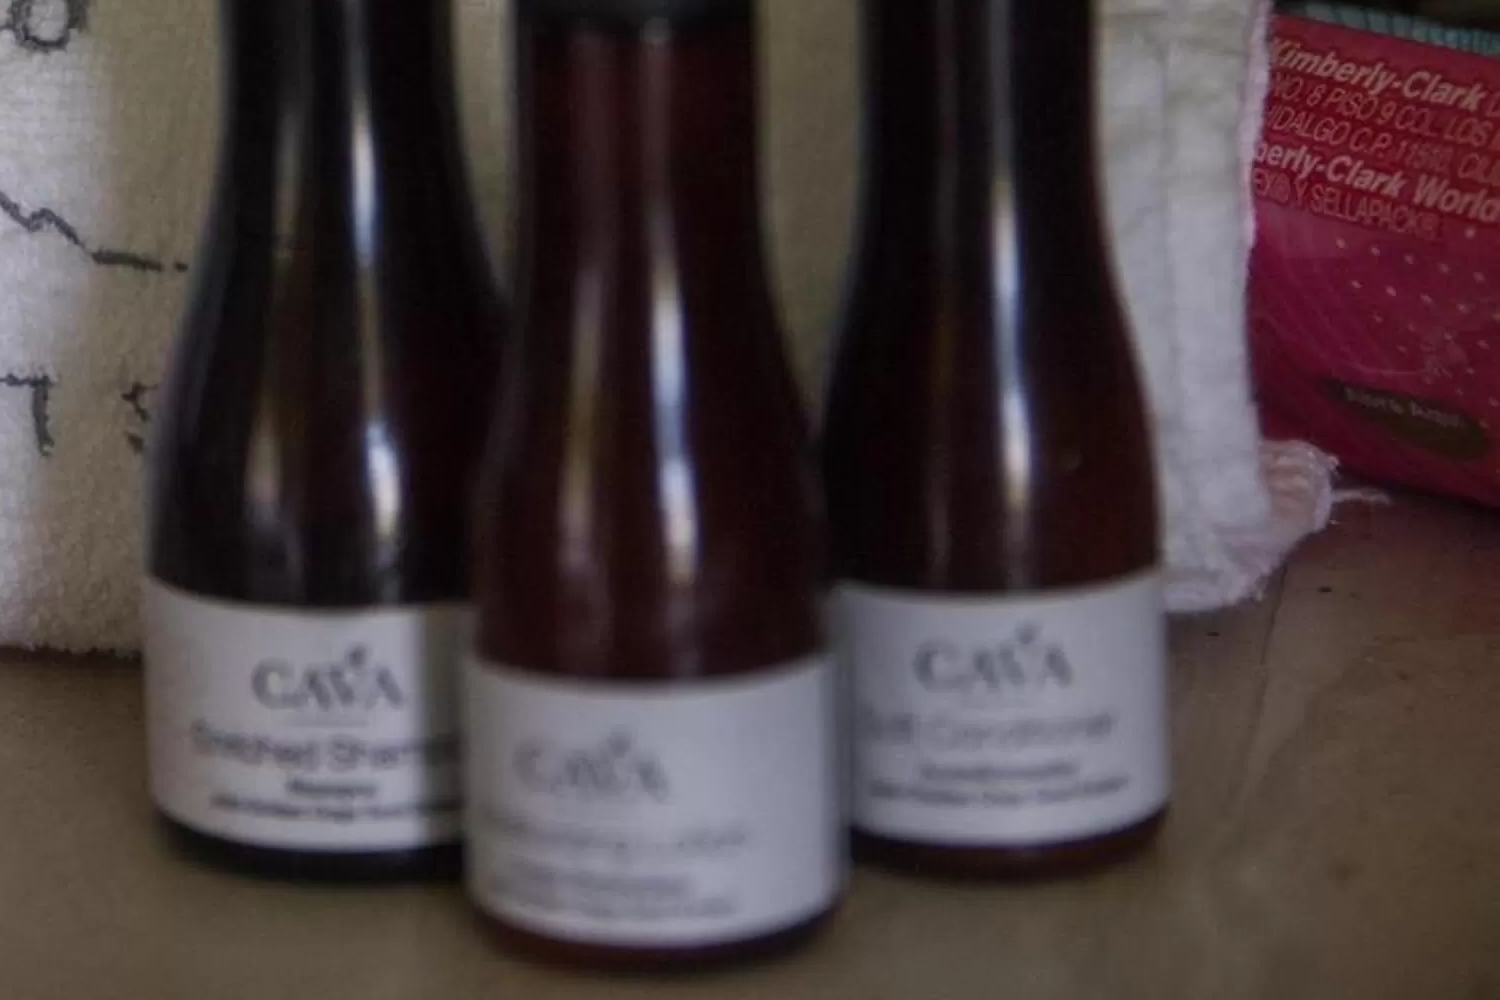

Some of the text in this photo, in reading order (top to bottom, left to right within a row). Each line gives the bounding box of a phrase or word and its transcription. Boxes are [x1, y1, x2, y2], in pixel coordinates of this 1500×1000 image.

[1271, 38, 1488, 113] Kimberly-Clark
[1306, 83, 1327, 107] 8
[1376, 101, 1397, 125] 9
